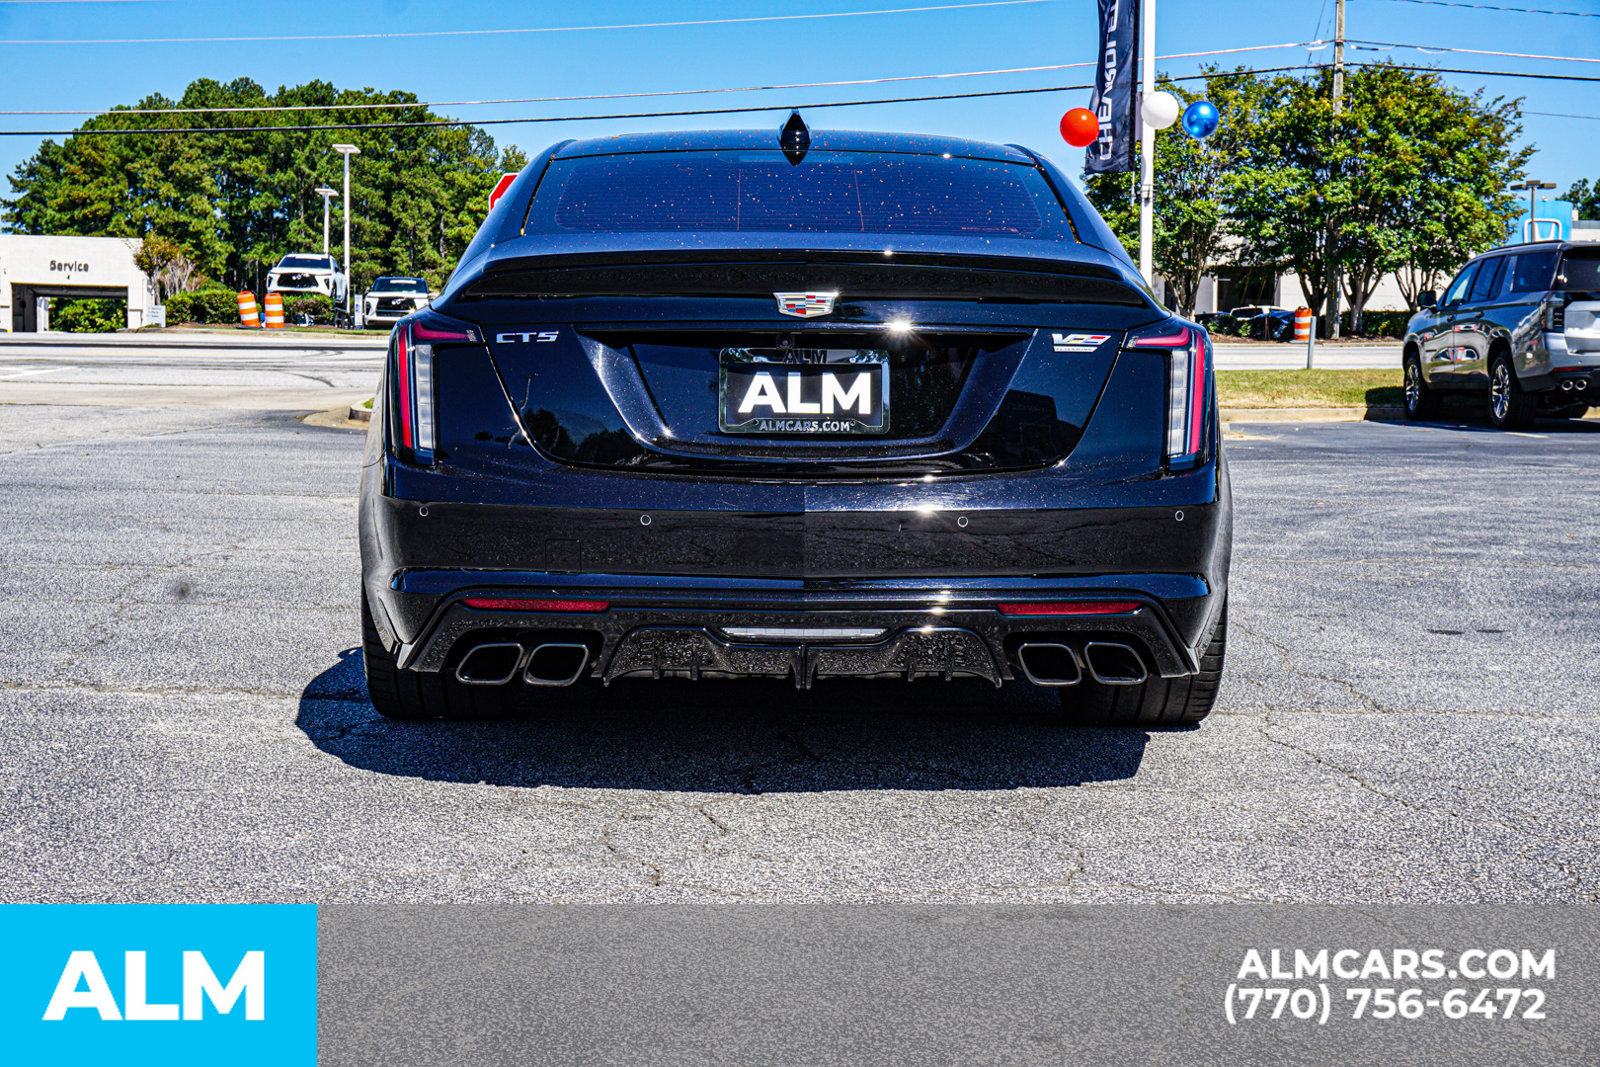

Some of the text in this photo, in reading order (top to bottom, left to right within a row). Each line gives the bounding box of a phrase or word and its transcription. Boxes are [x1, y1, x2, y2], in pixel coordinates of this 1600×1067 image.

[49, 259, 90, 272] Service
[496, 331, 559, 343] CT5
[783, 350, 828, 364] ALM
[737, 371, 872, 414] ALM
[759, 420, 850, 432] ALMCARS.COM
